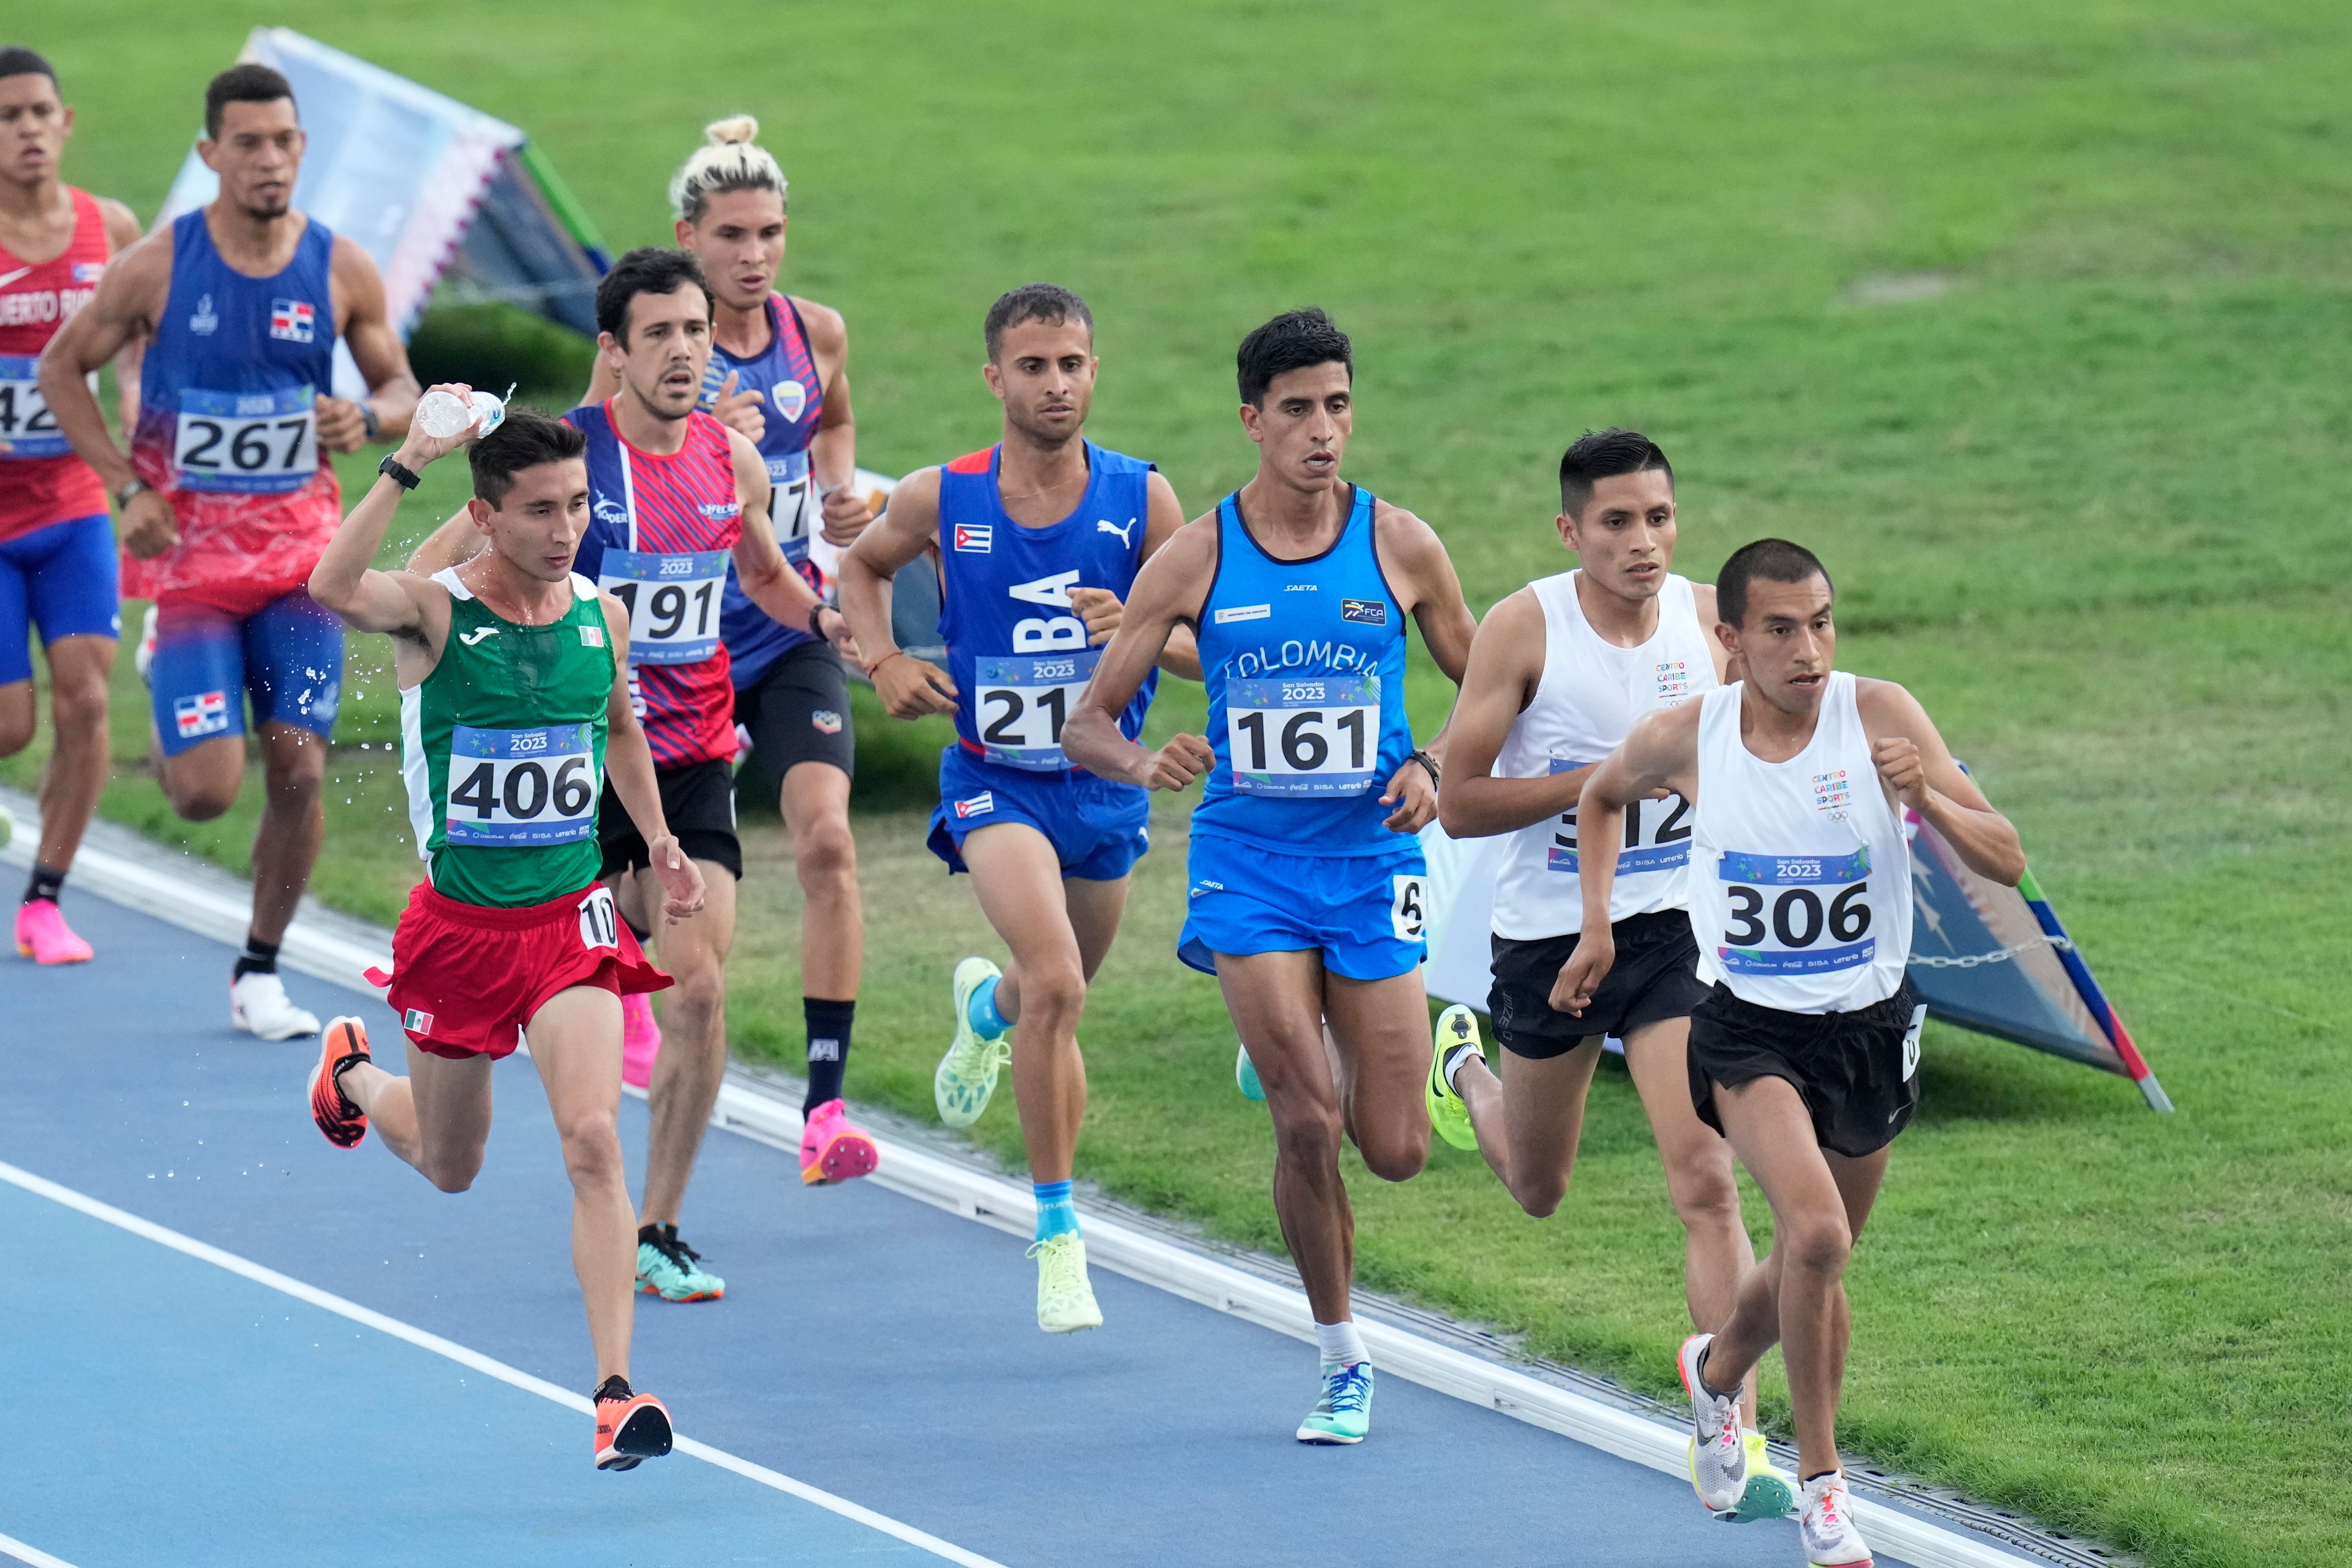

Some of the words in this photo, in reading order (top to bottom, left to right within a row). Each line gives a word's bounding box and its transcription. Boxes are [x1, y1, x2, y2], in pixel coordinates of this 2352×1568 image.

[182, 418, 307, 470] 267
[659, 562, 694, 575] 2023
[610, 581, 714, 639] 191
[1365, 608, 1384, 617] FCA
[1033, 664, 1075, 679] 2023
[1656, 662, 1684, 671] CENTRO
[1657, 672, 1686, 682] CARIBE
[1282, 687, 1326, 701] 2023
[1659, 683, 1688, 692] SPORTS
[510, 736, 548, 751] 2023
[1238, 709, 1364, 770] 161
[1812, 770, 1846, 783] CENTRO
[451, 758, 591, 819] 406
[1815, 781, 1849, 794] CARIBE
[1816, 792, 1850, 805] SPORTS
[1777, 864, 1822, 877] 2023
[1199, 879, 1224, 890] SAETA
[582, 897, 616, 944] 10
[1725, 882, 1872, 948] 306
